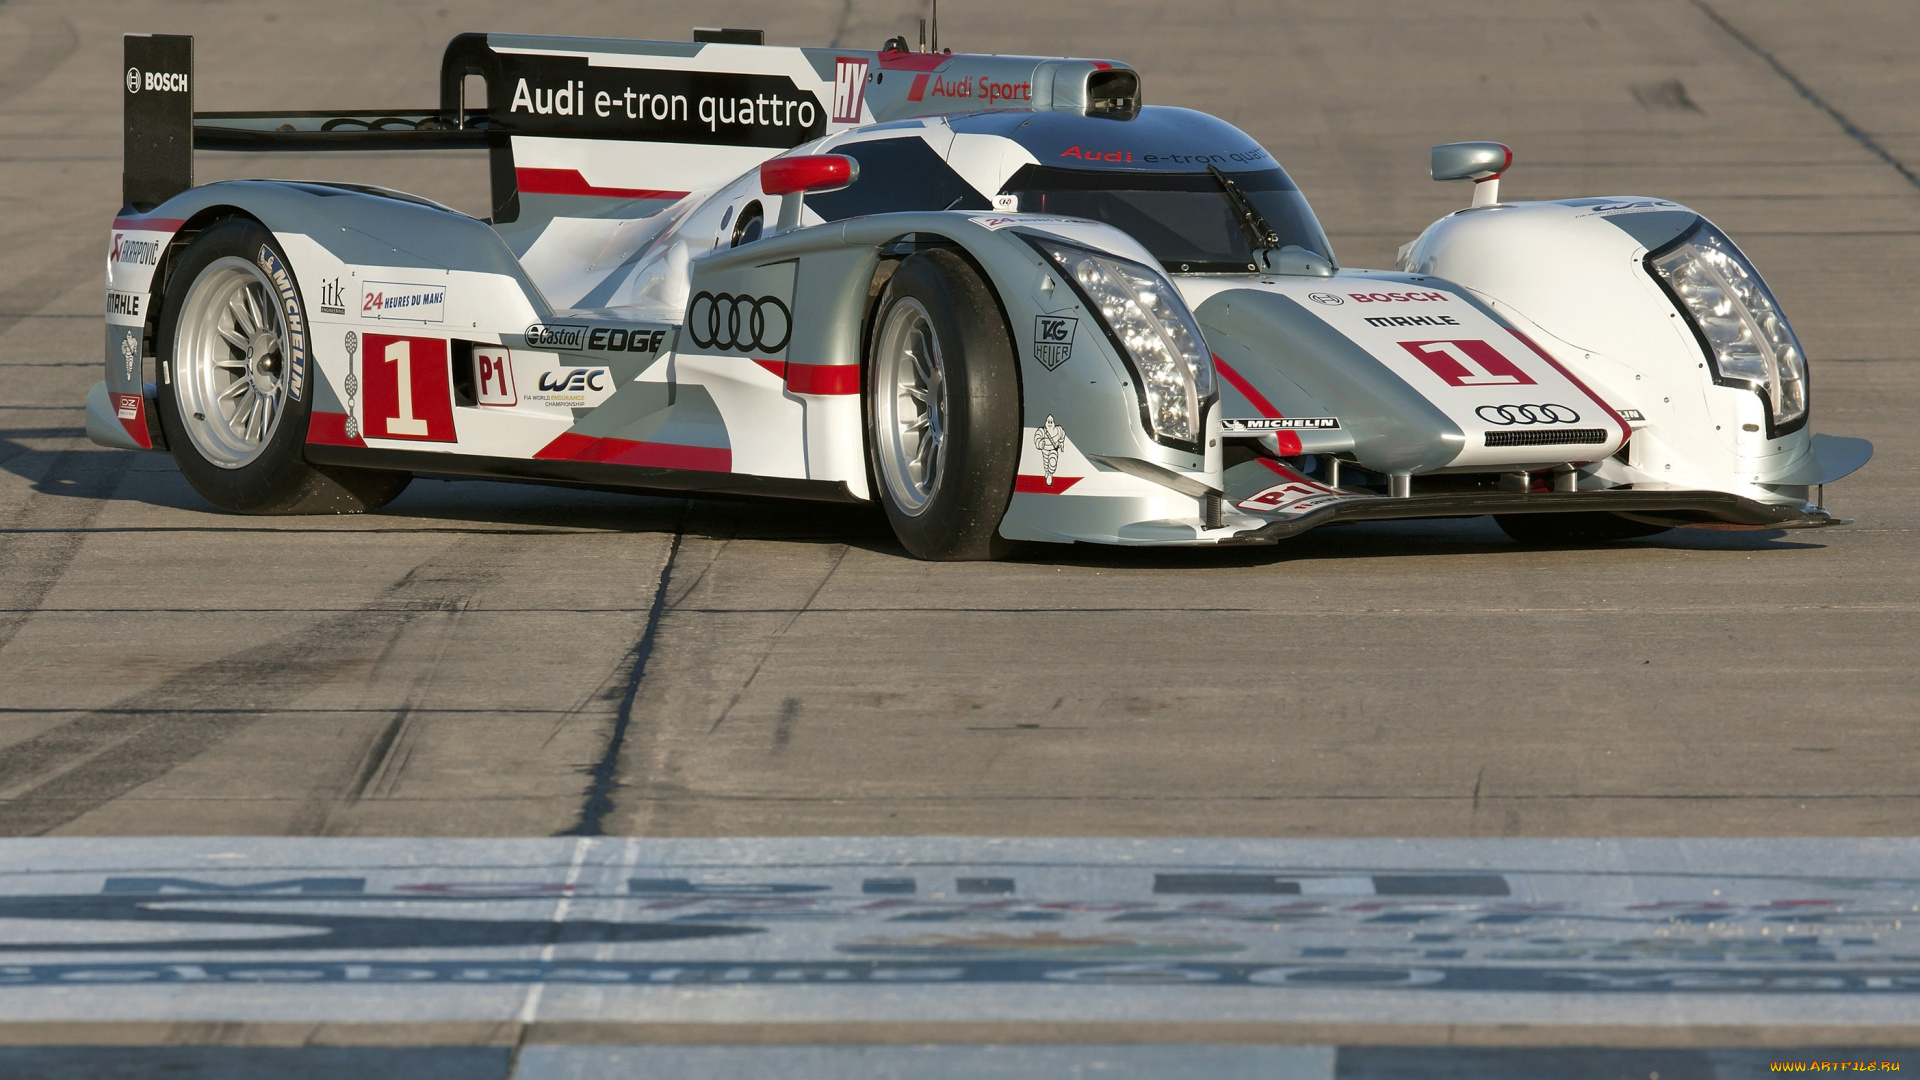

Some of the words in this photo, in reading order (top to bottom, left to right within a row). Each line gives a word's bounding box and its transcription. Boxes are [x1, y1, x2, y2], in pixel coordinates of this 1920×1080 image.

[145, 72, 188, 92] BOSCH
[833, 62, 868, 119] HY
[931, 75, 973, 98] Audi
[978, 77, 1032, 105] Sport
[510, 78, 584, 116] Audi
[595, 87, 688, 121] e-tron
[699, 93, 815, 132] quattro
[1060, 146, 1132, 163] Audi
[1144, 153, 1226, 164] e-tron
[321, 276, 345, 307] itk
[363, 292, 383, 311] 24
[384, 296, 410, 309] HEURES
[411, 295, 421, 306] DU
[423, 292, 443, 304] MANS
[1348, 292, 1449, 303] BOSCH
[107, 293, 139, 316] MAHLE
[1041, 320, 1069, 341] TAG
[1364, 316, 1461, 327] MAHLE
[272, 269, 304, 398] MICHELIN
[540, 328, 581, 346] Castrol
[588, 328, 667, 353] EDGE
[1036, 344, 1071, 367] HEUER
[1418, 341, 1516, 384] 1
[478, 355, 508, 396] P1
[538, 369, 605, 391] WEC
[385, 341, 428, 436] 1
[121, 398, 136, 407] OZ
[1247, 420, 1334, 428] MICHELIN
[1253, 485, 1316, 505] P1
